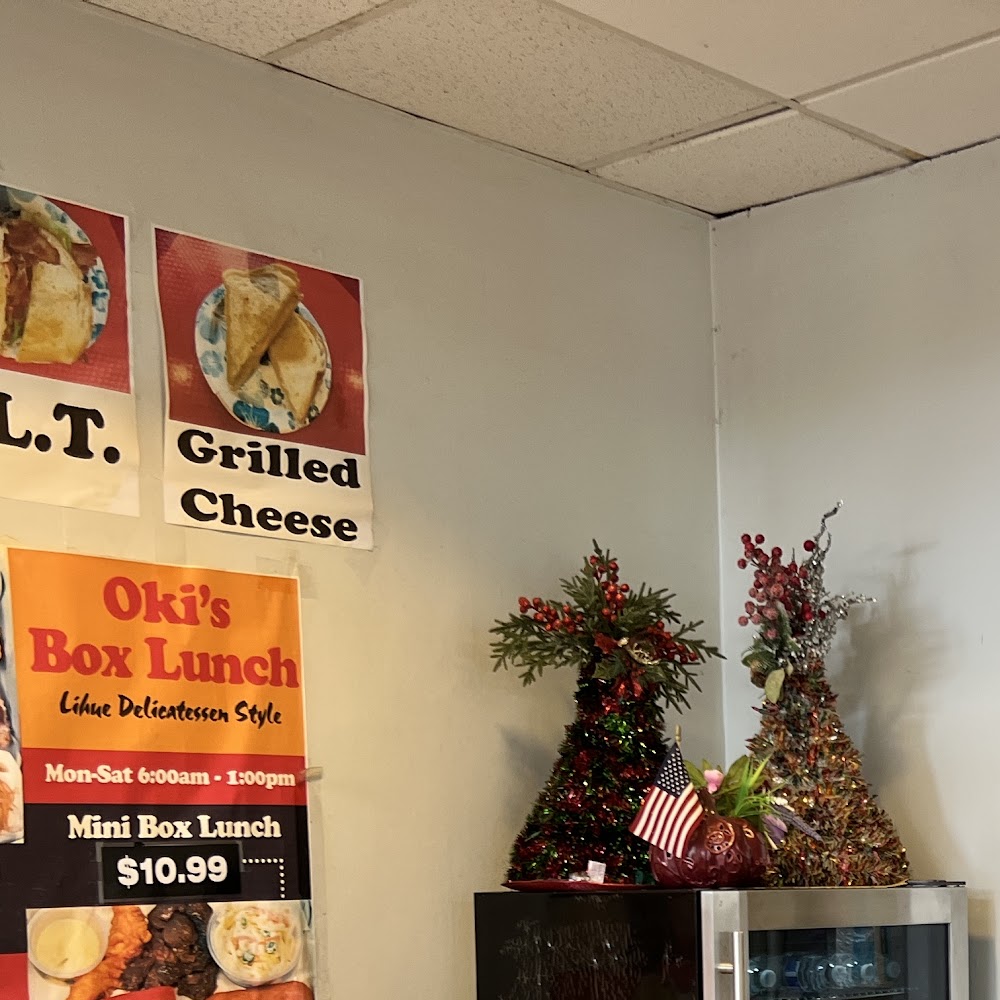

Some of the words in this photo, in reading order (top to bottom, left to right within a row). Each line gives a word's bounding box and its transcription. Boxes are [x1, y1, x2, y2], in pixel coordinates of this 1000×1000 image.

[177, 430, 361, 488] Grilled
[181, 488, 358, 541] Cheese
[103, 576, 231, 629] Oki's
[28, 627, 133, 678] Box
[145, 637, 299, 688] Lunch
[60, 691, 111, 718] Lihue
[118, 694, 229, 723] Delicatessen
[235, 701, 282, 729] Style
[45, 764, 133, 784] Mon-Sat
[138, 767, 210, 786] 6:00am
[226, 770, 296, 789] 1:00pm
[67, 815, 131, 839] Mini
[138, 815, 193, 839] Box
[198, 815, 281, 839] Lunch
[117, 855, 228, 889] $10.99
